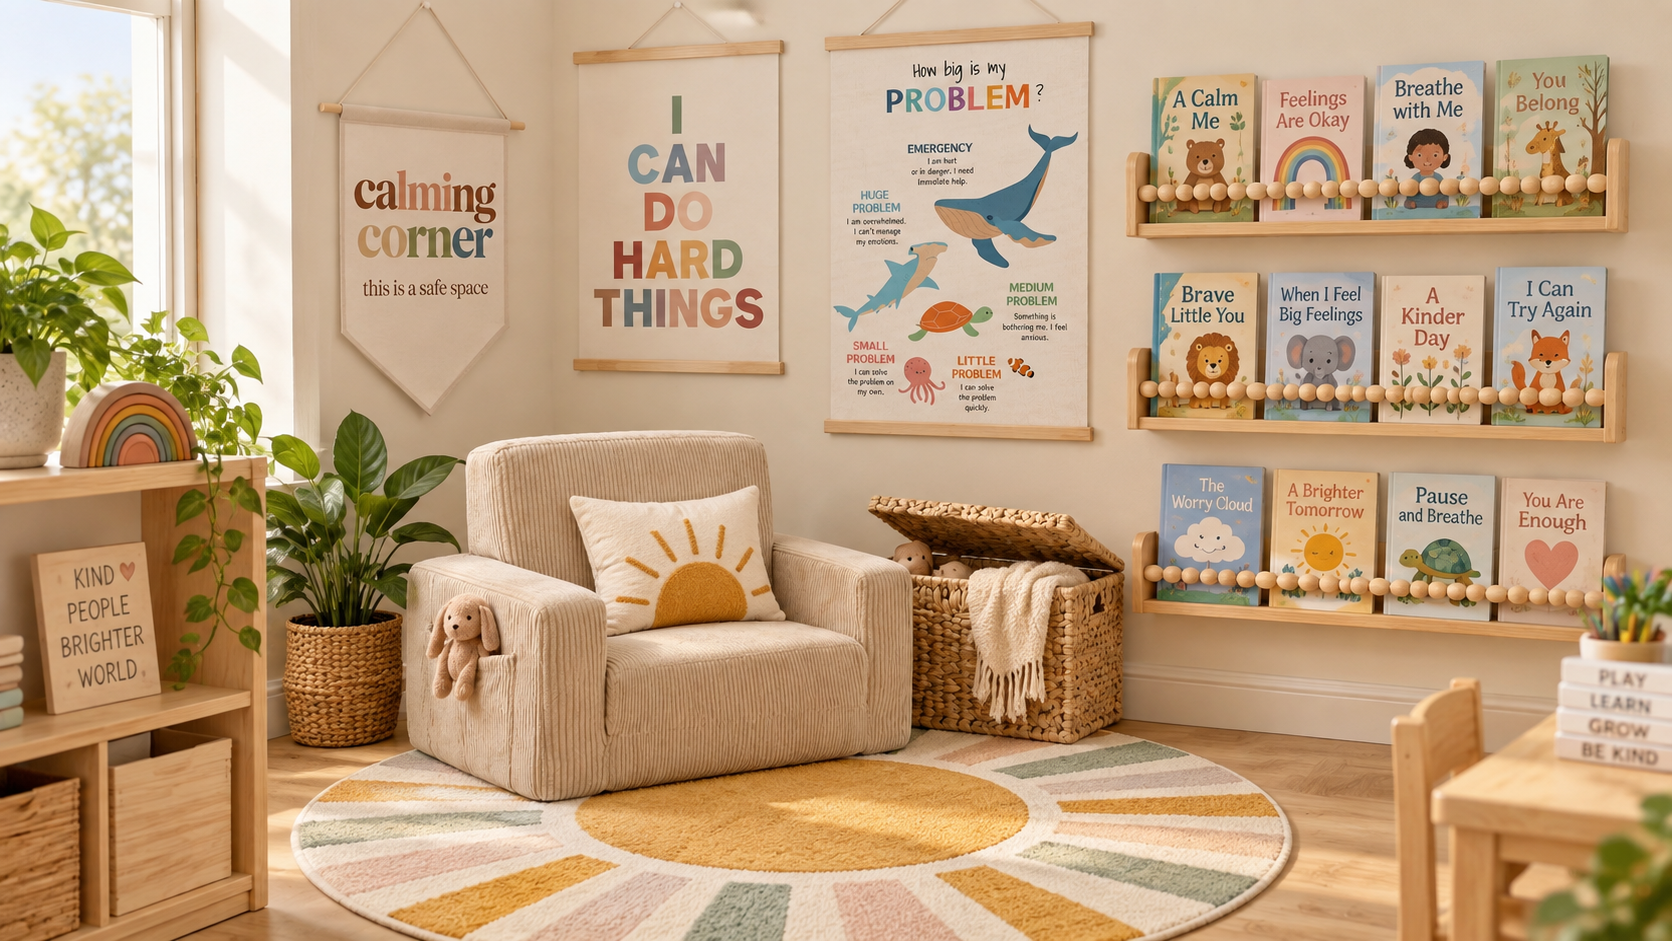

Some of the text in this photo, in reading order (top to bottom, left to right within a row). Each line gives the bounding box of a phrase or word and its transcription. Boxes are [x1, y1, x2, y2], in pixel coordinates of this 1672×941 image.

[912, 60, 1007, 83] How big is my
[1532, 71, 1566, 90] You
[1394, 76, 1463, 98] Breathe
[886, 83, 1030, 113] PROBLEM
[1172, 88, 1239, 109] A Calm
[1280, 89, 1347, 110] Feelings
[1515, 93, 1580, 115] Belong
[671, 95, 682, 134] I
[1393, 100, 1463, 120] with Me
[1191, 111, 1220, 130] Me
[1276, 111, 1350, 132] Are Okay
[907, 142, 973, 154] EMERGENCY
[627, 142, 726, 185] CAN
[927, 157, 931, 165] I
[919, 167, 926, 175] in
[927, 167, 952, 177] danger.
[957, 166, 974, 175] need
[354, 169, 497, 224] calming
[860, 190, 889, 200] HUGE
[644, 191, 713, 231] DO
[852, 202, 901, 214] PROBLEM
[858, 227, 875, 235] can't
[357, 224, 494, 259] corner
[855, 239, 866, 247] my
[613, 239, 744, 280] HARD
[362, 278, 489, 299] this is a safe space
[1009, 282, 1054, 292] MEDIUM
[1181, 285, 1235, 303] Brave
[1280, 285, 1361, 302] When I Feel
[1425, 286, 1440, 304] A
[1526, 280, 1574, 297] I Can
[593, 287, 764, 329] THINGS
[1006, 295, 1058, 306] PROBLEM
[1050, 312, 1056, 320] is
[1170, 306, 1245, 323] Little You
[1279, 306, 1363, 326] Big Feelings
[1401, 307, 1465, 325] Kinder
[1507, 300, 1592, 322] Try Again
[1002, 323, 1034, 333] bothering
[1054, 323, 1068, 331] feel
[853, 341, 889, 350] SMALL
[1414, 329, 1450, 351] Day
[846, 353, 895, 364] PROBLEM
[957, 355, 996, 366] LITTLE
[847, 377, 859, 385] the
[859, 377, 885, 387] problem
[951, 368, 1002, 380] PROBLEM
[857, 389, 867, 397] my
[958, 393, 997, 402] the problem
[1199, 477, 1225, 493] The
[1287, 481, 1364, 502] A Brighter
[1171, 494, 1253, 513] Worry Cloud
[1415, 486, 1468, 506] Pause
[1522, 491, 1584, 509] You Are
[1285, 501, 1365, 519] Tomorrow
[1398, 507, 1483, 525] and Breathe
[1518, 510, 1587, 535] Enough
[73, 564, 115, 590] KIND
[67, 594, 131, 624] PEOPLE
[60, 624, 145, 658] BRIGHTER
[77, 658, 138, 689] WORLD
[1598, 668, 1648, 688] PLAY
[1590, 693, 1652, 714] LEARN
[1588, 718, 1650, 739] GROW
[1582, 742, 1659, 766] BE KIND
